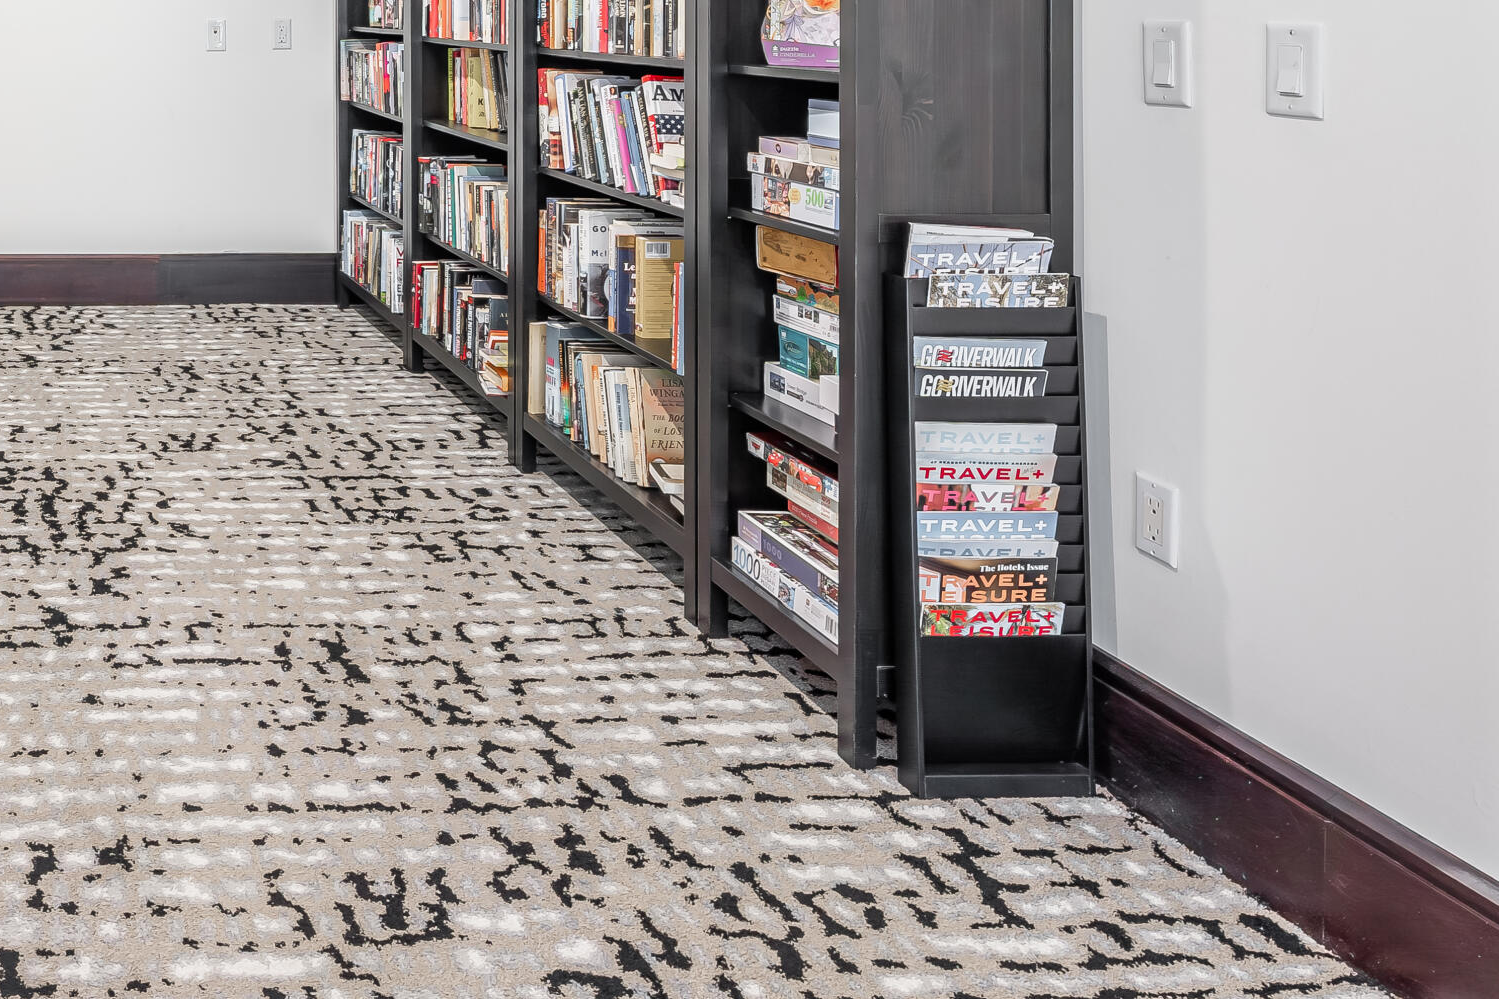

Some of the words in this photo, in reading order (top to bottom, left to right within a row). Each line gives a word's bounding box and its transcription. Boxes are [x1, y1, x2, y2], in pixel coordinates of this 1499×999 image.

[652, 85, 684, 102] AM
[805, 188, 824, 208] 500
[917, 252, 1041, 266] TRAVEL+
[937, 281, 1060, 296] TRAVEL+
[946, 345, 1037, 367] RIVERWALK
[946, 375, 1037, 397] RIVERWALK
[650, 389, 684, 398] WINGA
[668, 413, 684, 423] BOO
[664, 427, 682, 436] LOS
[919, 431, 1045, 445] TRAVEL+
[651, 440, 684, 451] FRIEN
[919, 467, 1044, 480] TRAVEL+
[922, 489, 1049, 504] TRAVEL+
[920, 519, 1047, 533] TRAVEL+
[733, 544, 761, 580] 1000
[980, 564, 996, 573] The
[997, 563, 1025, 571] Hotels
[1026, 563, 1049, 571] Issue
[919, 573, 1048, 588] TRAVEL+
[921, 588, 1047, 602] LEISURE
[930, 609, 1055, 623] TRAVEL+
[930, 623, 1053, 636] LEISURE
